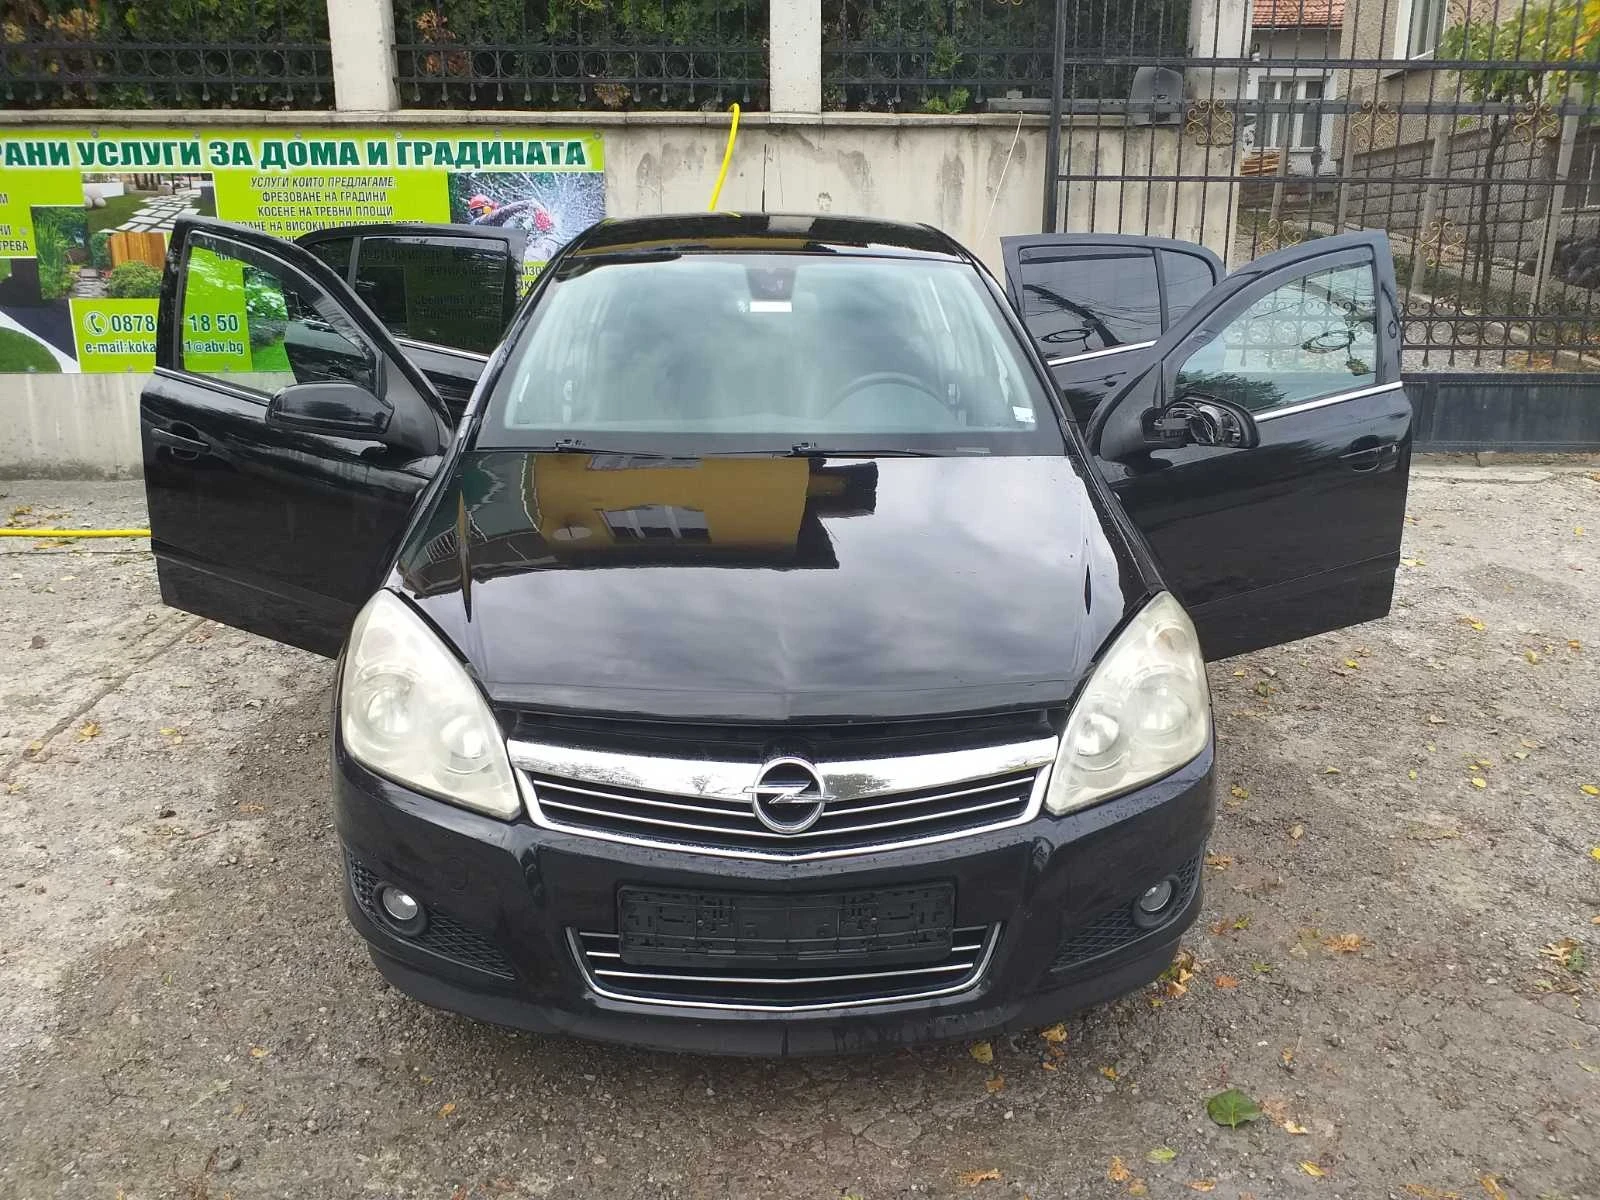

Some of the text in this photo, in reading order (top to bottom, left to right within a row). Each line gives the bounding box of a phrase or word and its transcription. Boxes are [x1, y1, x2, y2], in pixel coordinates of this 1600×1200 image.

[0, 141, 586, 169] АНИ УСЛУГИ ЗА ДОМА И ГРАДИНАТА
[251, 177, 394, 188] УСЛУГИ КОИТО ПРЕДЛАГАМЕ
[262, 191, 387, 202] ФРЕЗОВАНЕ НА ГРАДИНИ
[258, 206, 394, 218] КОСЕНЕ НА ТРЕВНИ ПЛОЩИ
[270, 221, 283, 232] НА
[111, 315, 238, 332] 0878 18 50
